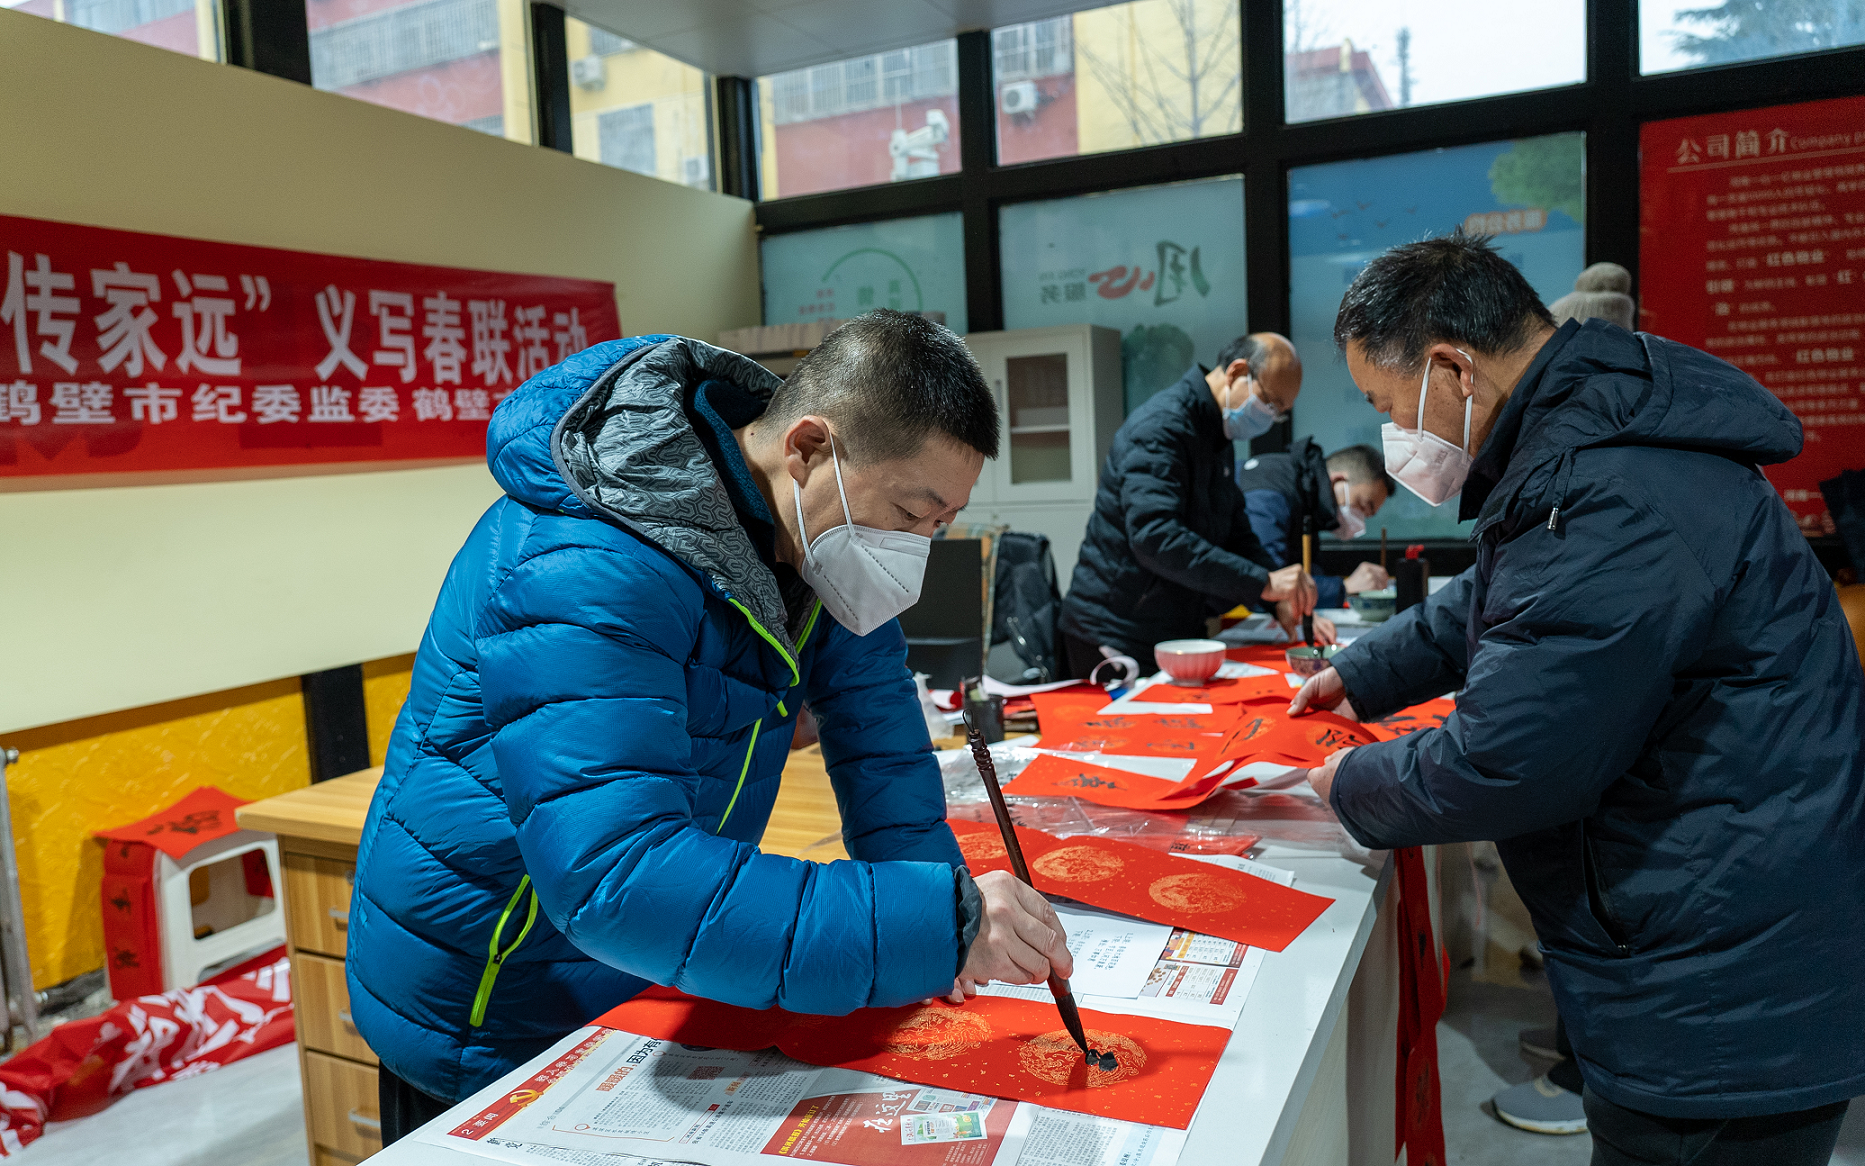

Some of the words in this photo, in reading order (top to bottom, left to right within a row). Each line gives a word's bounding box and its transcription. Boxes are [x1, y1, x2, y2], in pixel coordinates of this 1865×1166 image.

[313, 283, 588, 385] 义写春联活动
